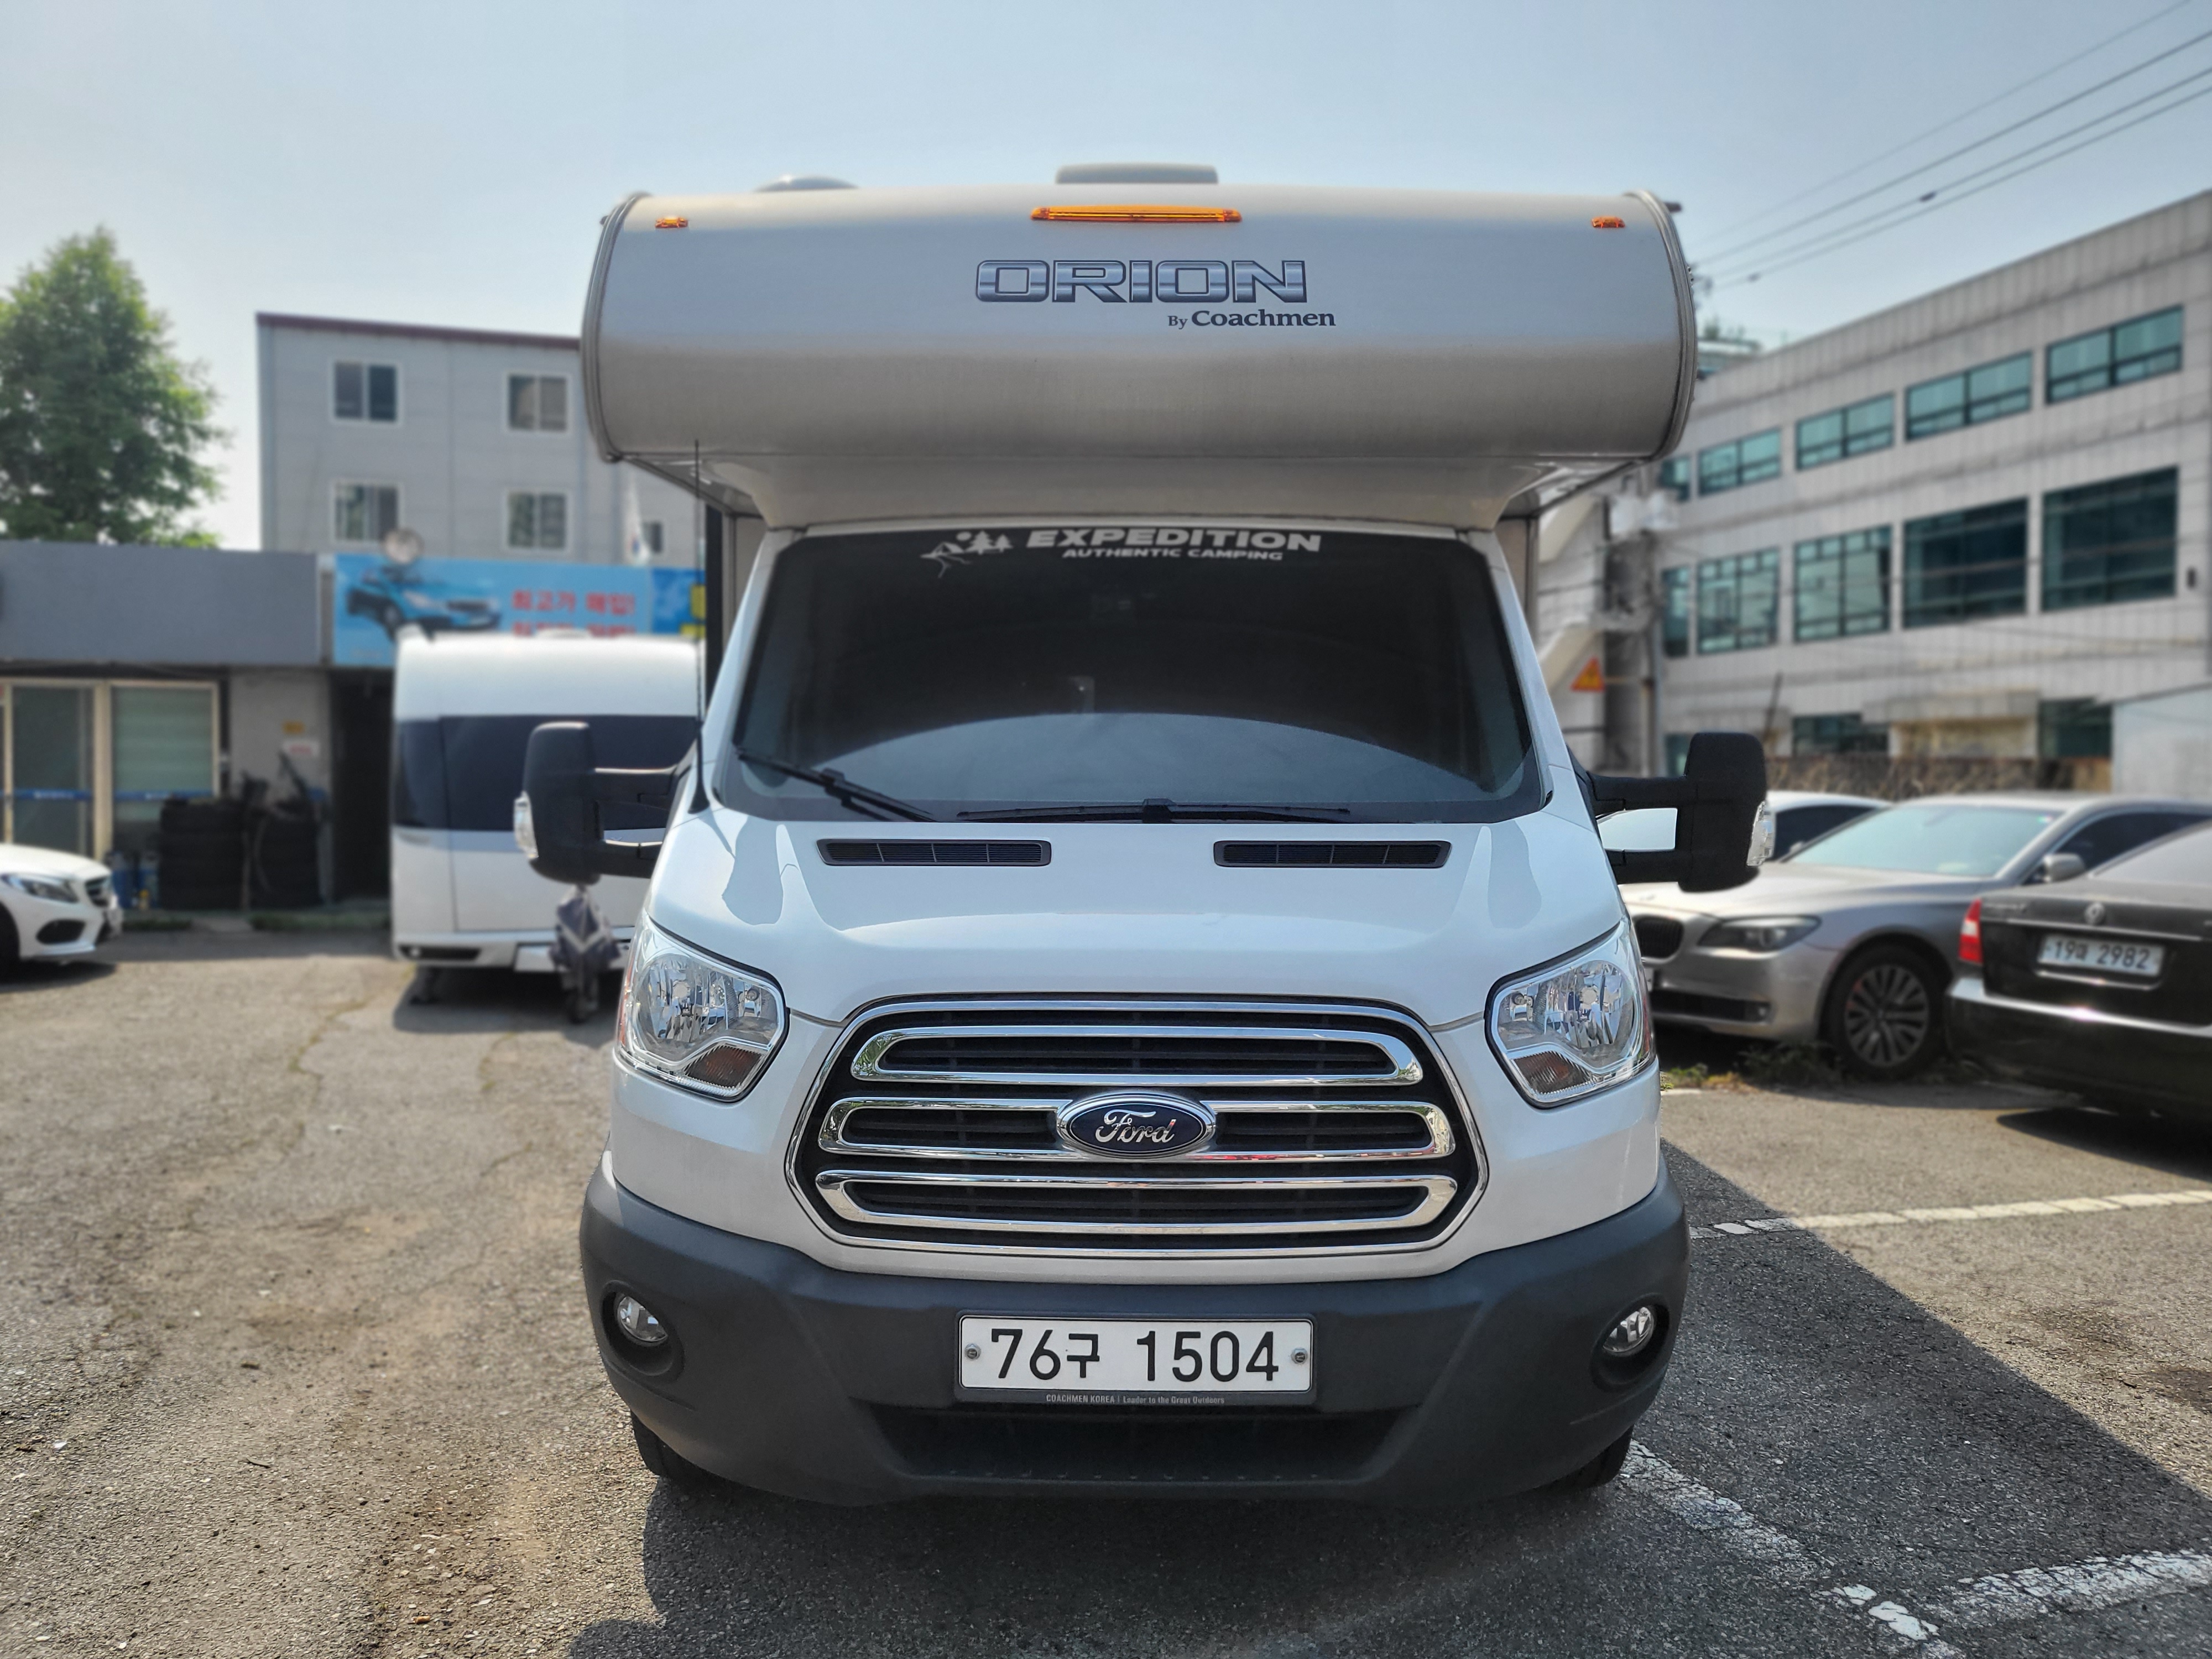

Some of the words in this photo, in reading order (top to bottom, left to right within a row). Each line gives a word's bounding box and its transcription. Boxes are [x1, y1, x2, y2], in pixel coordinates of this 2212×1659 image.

[975, 260, 1307, 303] ORION
[1168, 314, 1188, 329] By
[1191, 309, 1336, 327] Coachmen
[1026, 529, 1321, 552] EXPEDITION
[1061, 547, 1182, 559] AUTHENTIC
[1188, 548, 1284, 561] CAMPING
[2096, 943, 2150, 970] 2982
[1095, 1109, 1177, 1143] Ford
[991, 1329, 1100, 1380] 76구
[1136, 1330, 1279, 1382] 1504
[1046, 1394, 1088, 1404] COACHMEN
[1090, 1394, 1115, 1404] KOREA
[1192, 1396, 1225, 1404] Outdoors
